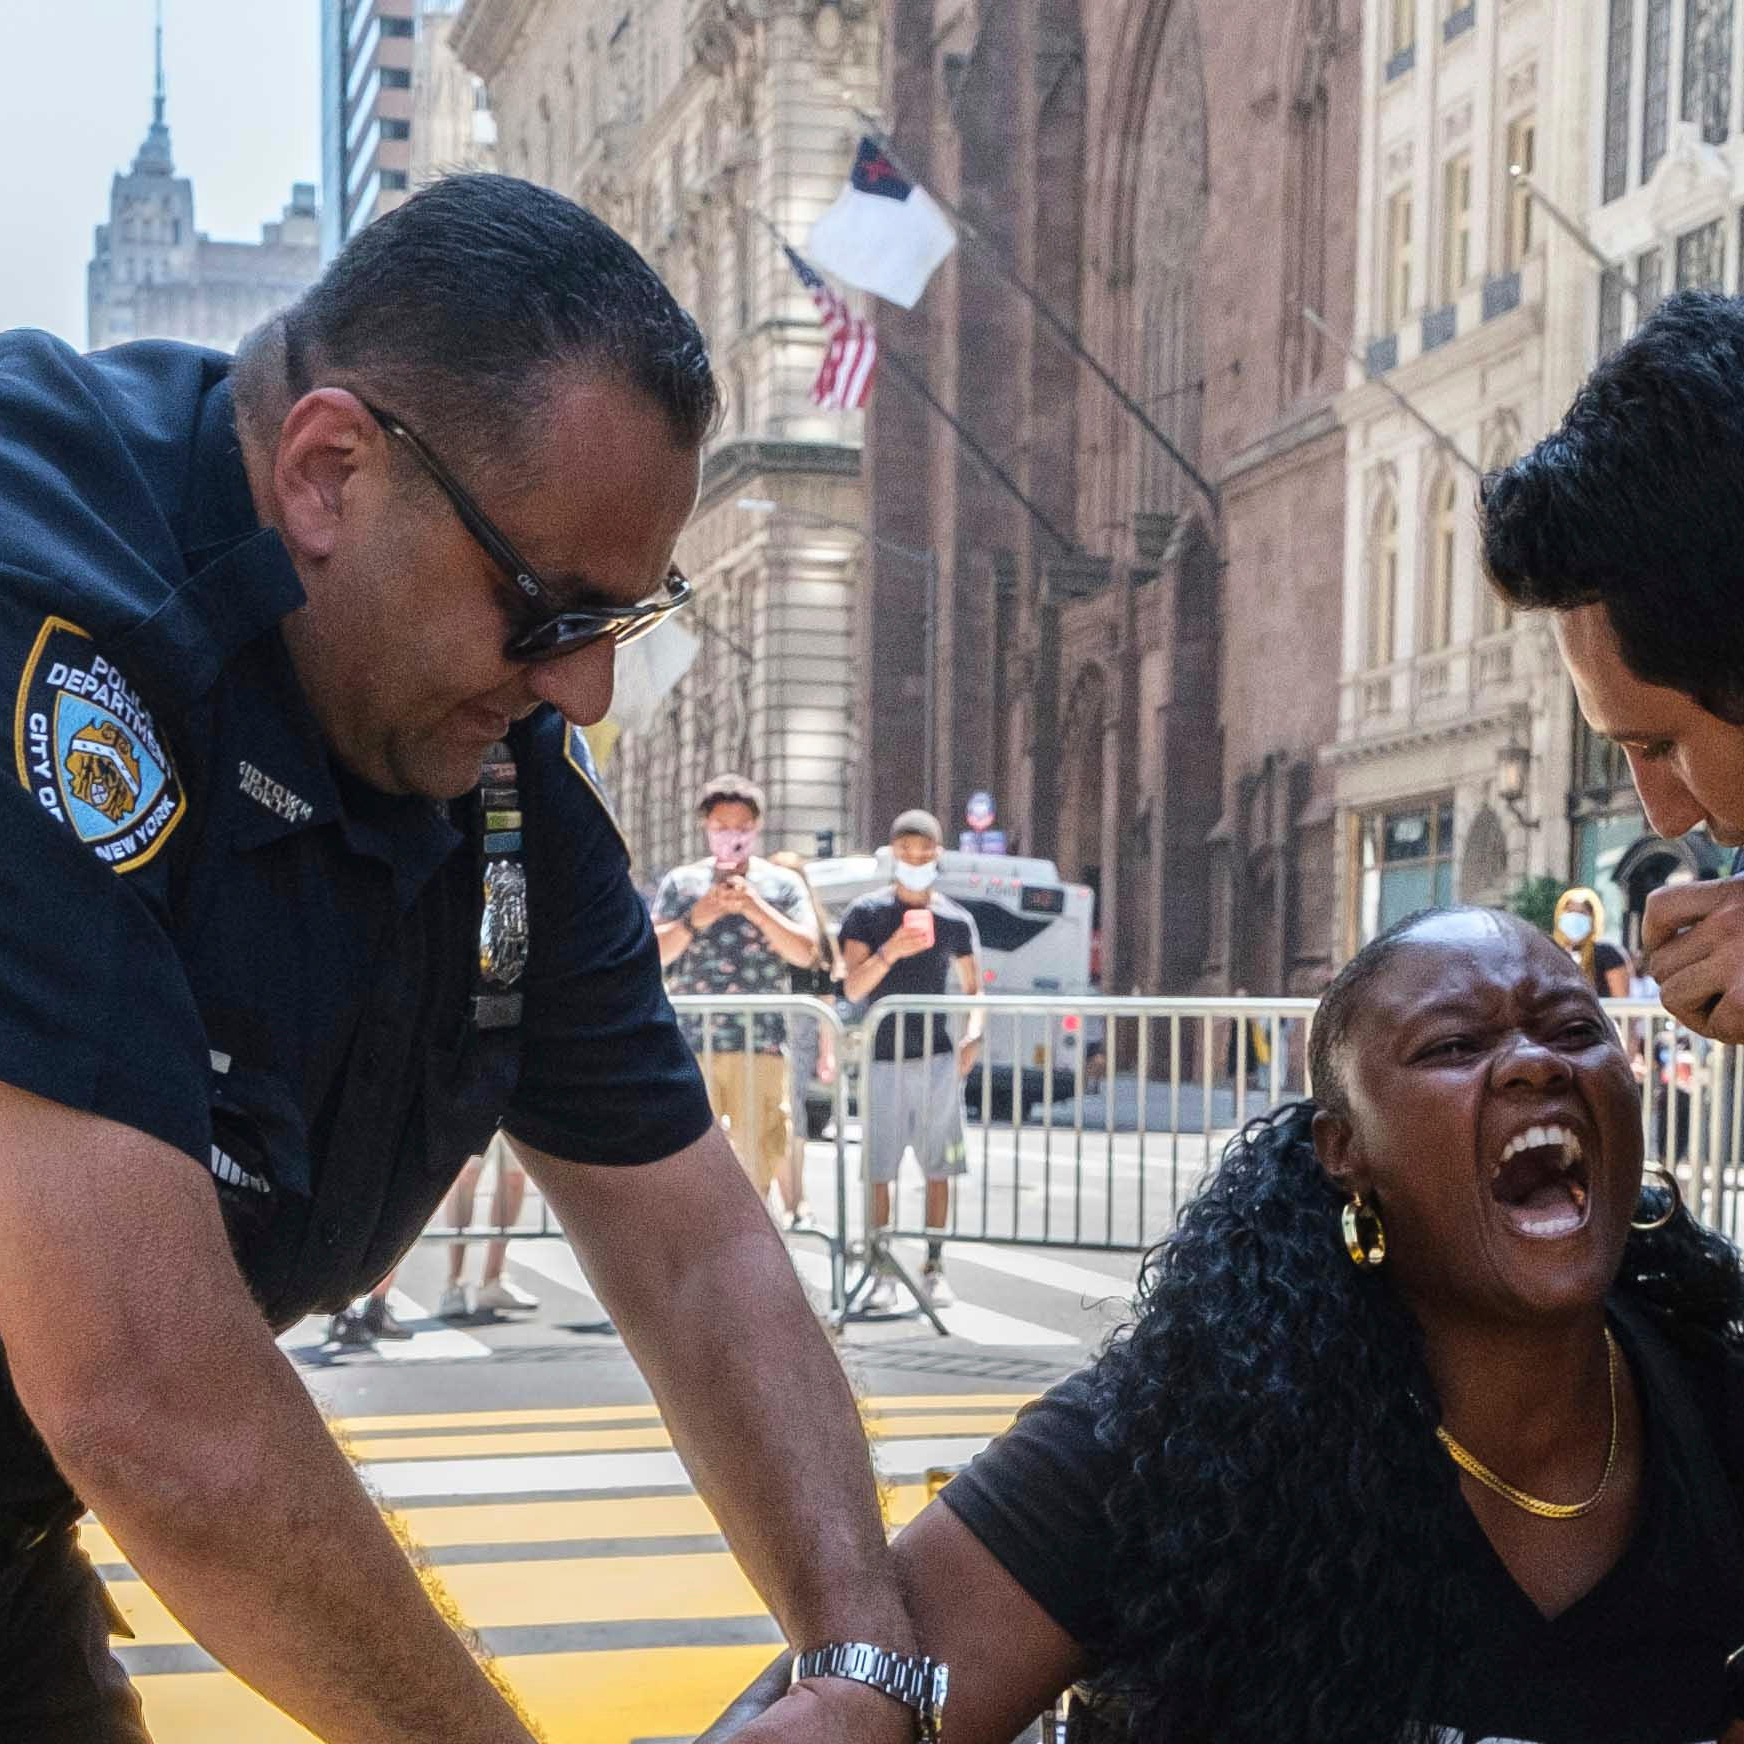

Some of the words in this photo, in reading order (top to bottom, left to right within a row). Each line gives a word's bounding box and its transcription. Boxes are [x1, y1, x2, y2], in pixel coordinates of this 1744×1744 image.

[29, 712, 53, 780] CITY
[46, 662, 172, 780] DEPARTMENT
[38, 786, 65, 824] OF
[94, 833, 138, 862] NEW
[135, 793, 177, 844] YORK
